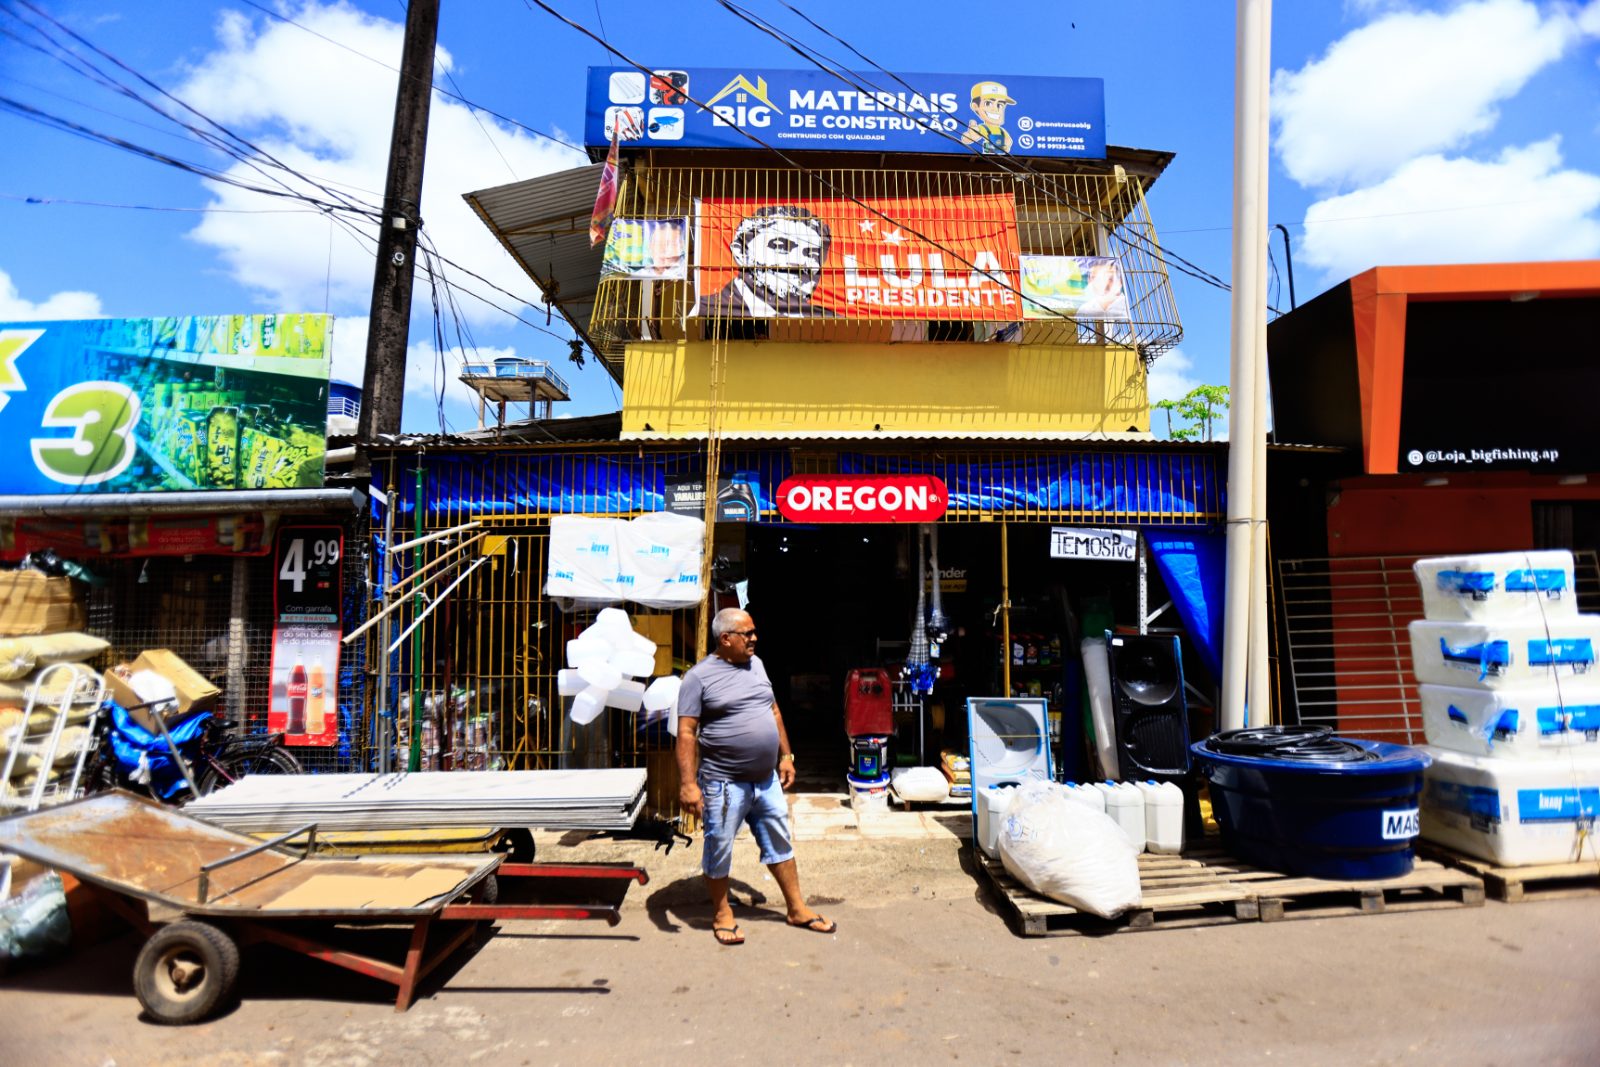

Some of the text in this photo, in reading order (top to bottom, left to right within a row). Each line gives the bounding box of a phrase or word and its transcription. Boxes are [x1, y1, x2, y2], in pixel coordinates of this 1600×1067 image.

[790, 90, 958, 113] MATERIAIS
[713, 105, 771, 128] BIG
[790, 114, 958, 134] DE CONSTRUÇÃO
[778, 132, 827, 140] CONSTRUINDO
[843, 251, 1012, 288] LULA
[846, 288, 1016, 307] PRESIDENTE
[30, 380, 141, 486] 3
[1426, 448, 1559, 464] @Loja_bigfishing.ap
